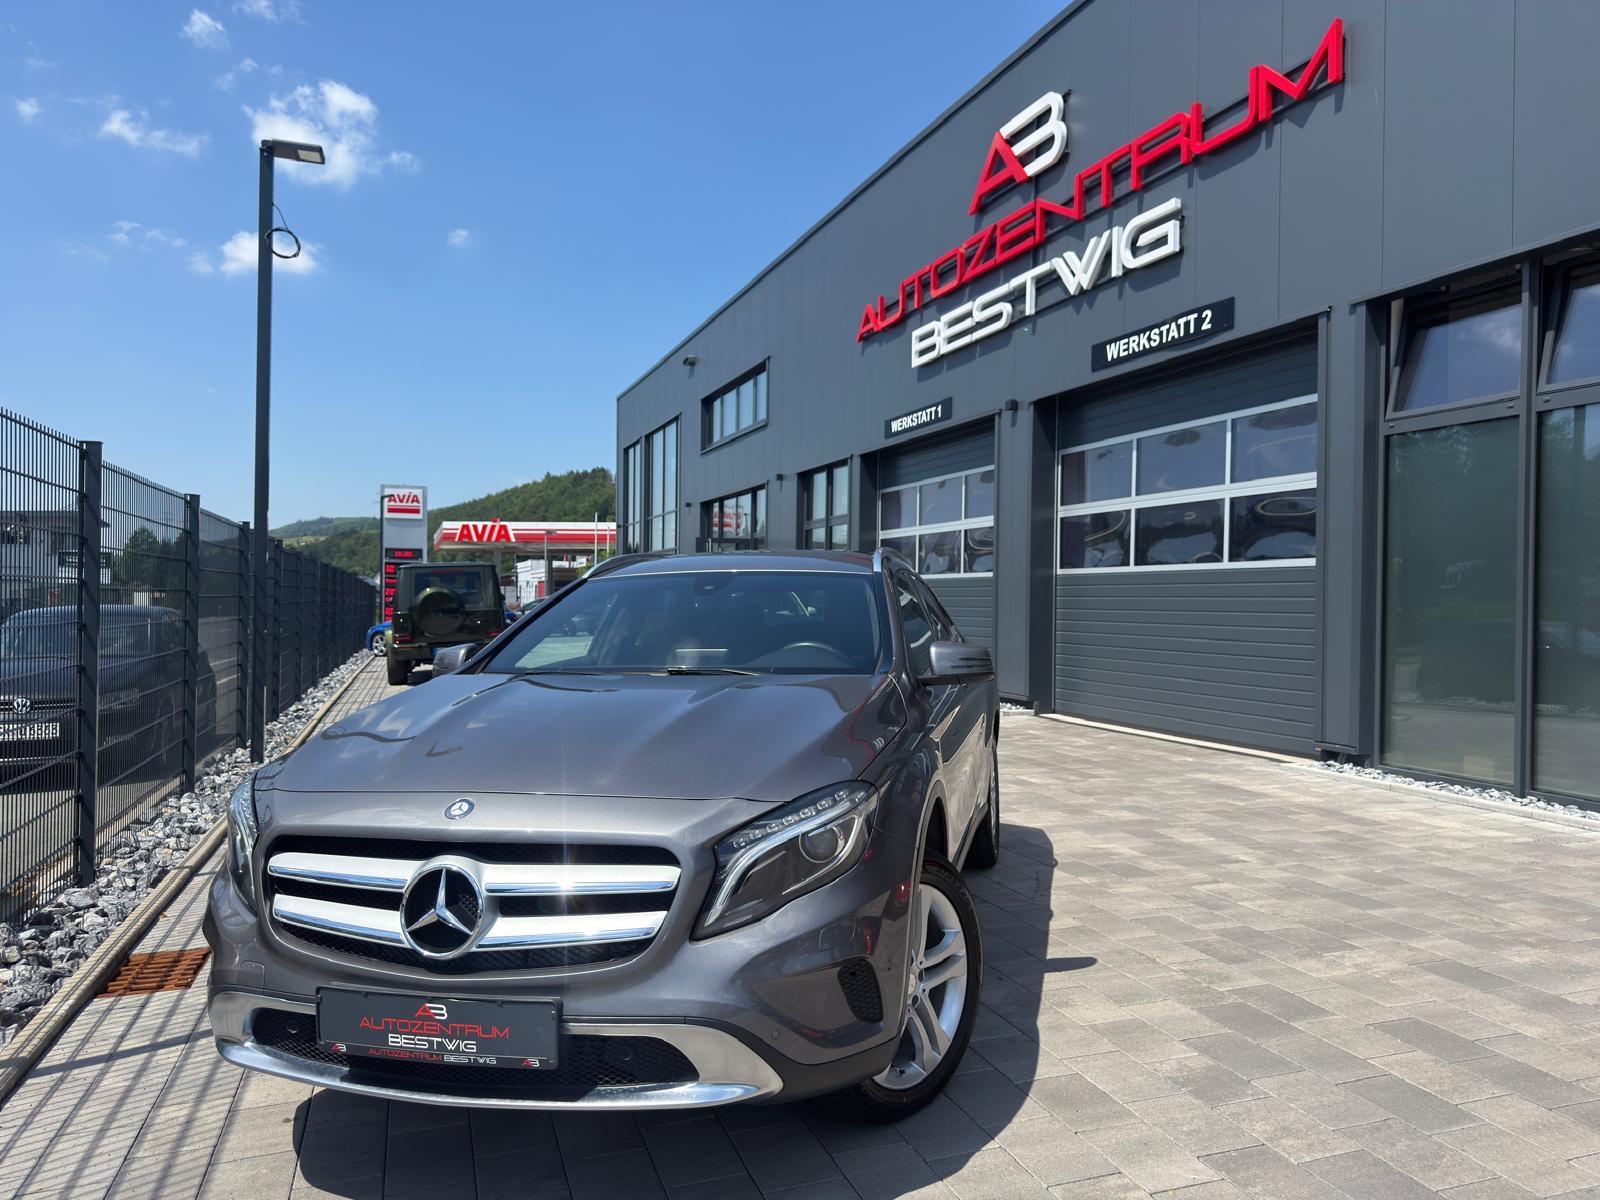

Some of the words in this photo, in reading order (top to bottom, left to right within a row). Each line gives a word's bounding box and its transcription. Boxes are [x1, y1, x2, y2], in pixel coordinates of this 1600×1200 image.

[856, 17, 1344, 342] AUTOZENTRUM
[911, 197, 1182, 368] BESTWIG
[1105, 313, 1198, 362] WERKSTATT
[1201, 309, 1213, 331] 2
[890, 407, 936, 433] WERKSTATT
[937, 404, 942, 419] 1
[359, 1016, 511, 1039] AUTOZENTRUM
[368, 1048, 442, 1061] AUTOZENTRUM
[443, 1054, 497, 1065] BESTWIG
[388, 1033, 477, 1053] BESTWIG
